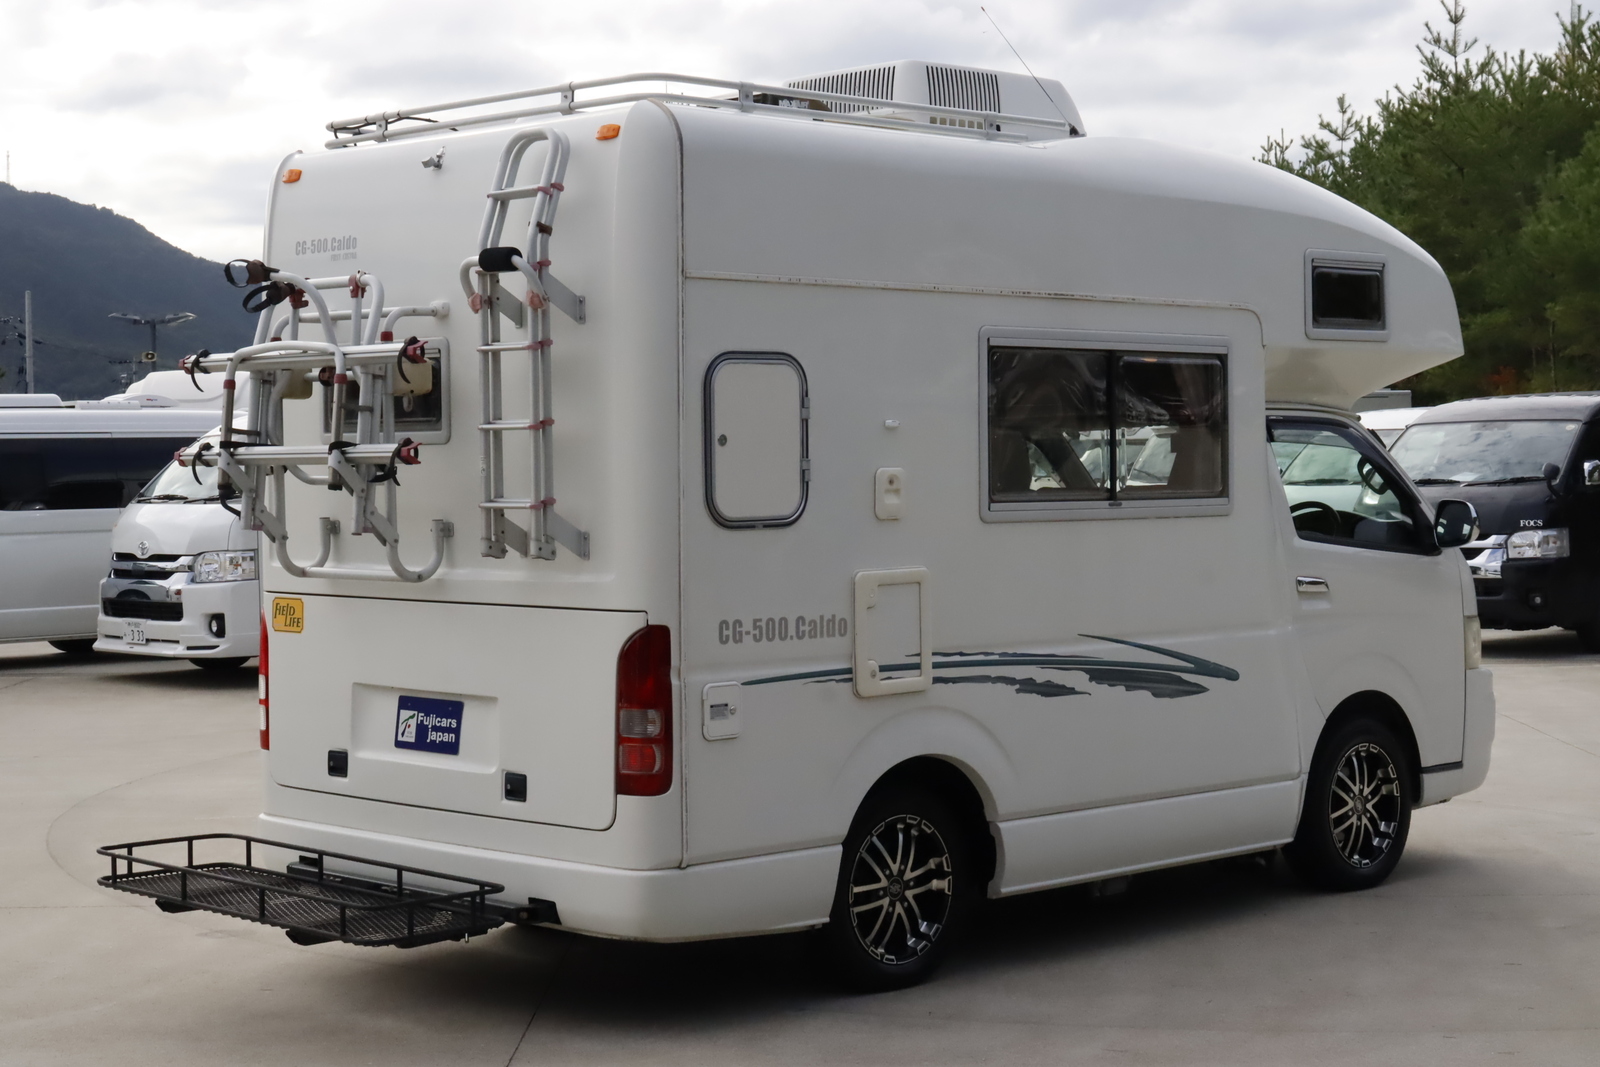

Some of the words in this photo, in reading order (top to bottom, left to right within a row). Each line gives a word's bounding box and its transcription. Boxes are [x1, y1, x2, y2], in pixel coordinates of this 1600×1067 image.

[295, 235, 357, 256] CG-500.Caldo
[1520, 519, 1543, 527] FOCS
[274, 602, 296, 619] FIELD
[284, 616, 302, 628] LIFE
[718, 614, 848, 645] CG-500.Caldo
[417, 712, 457, 728] Fujicars
[426, 728, 456, 743] japan
